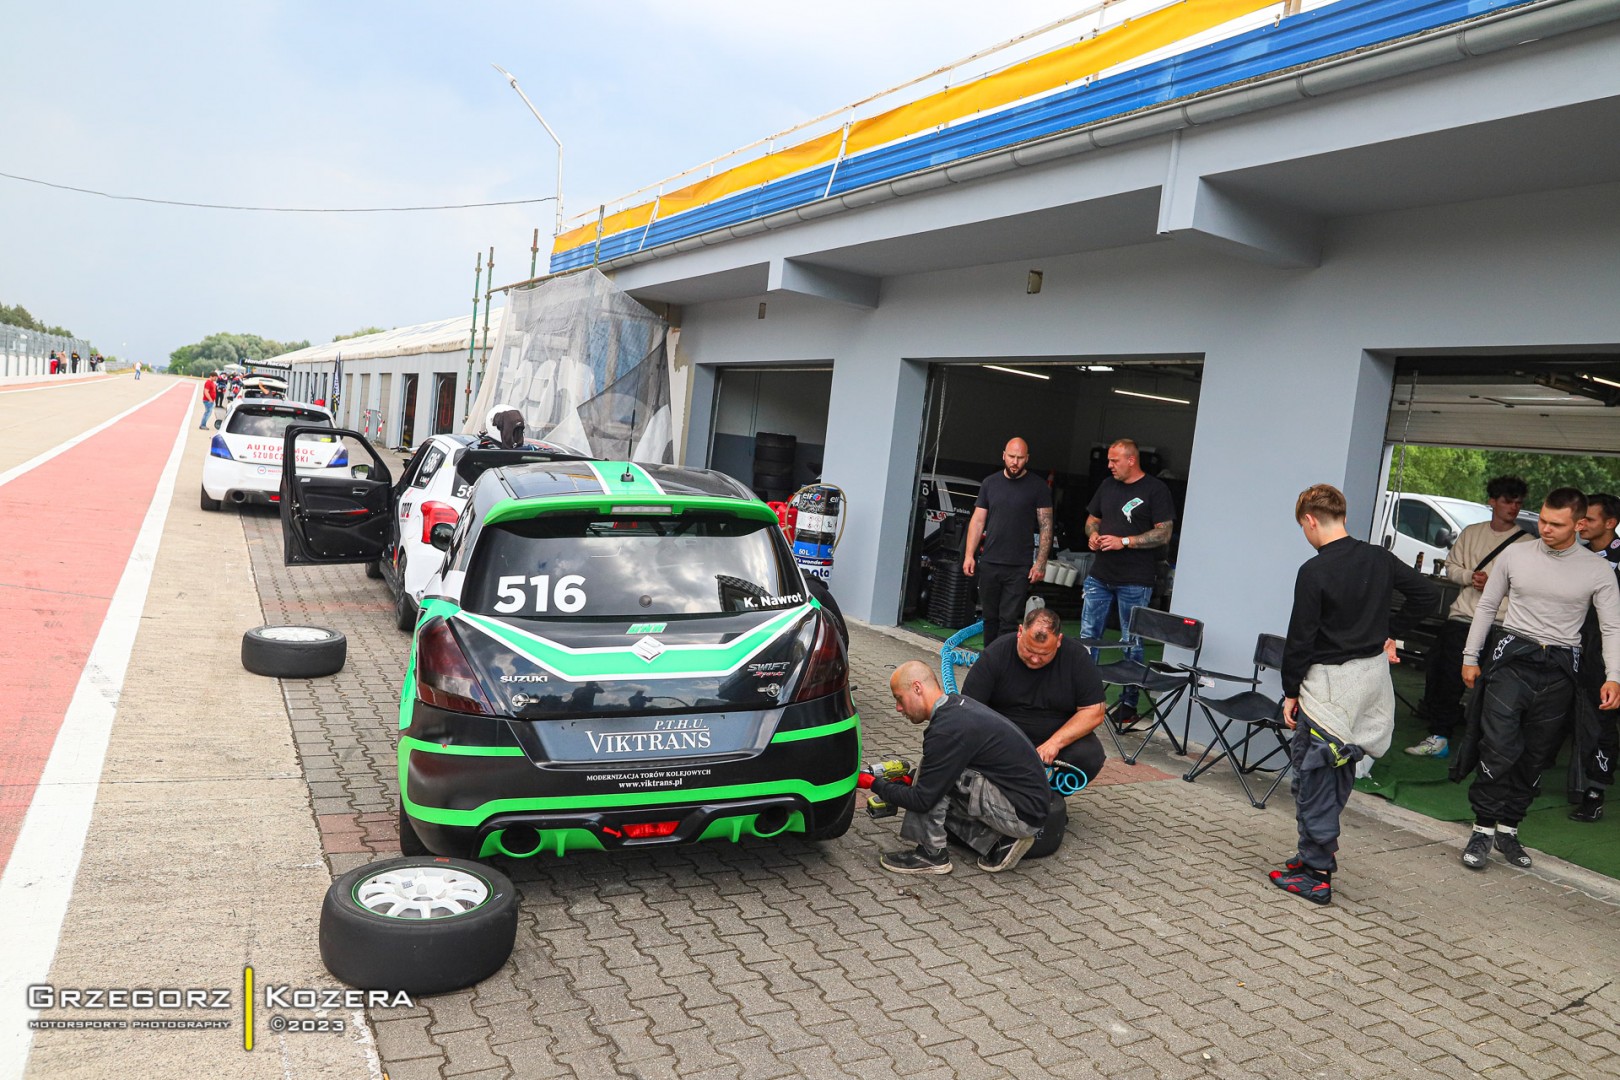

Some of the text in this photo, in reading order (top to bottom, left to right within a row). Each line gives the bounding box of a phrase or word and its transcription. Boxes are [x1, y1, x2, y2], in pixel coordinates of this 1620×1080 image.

[246, 443, 316, 456] AUTOPMOC
[802, 492, 813, 500] elf
[493, 574, 587, 613] 516
[743, 592, 803, 608] K. Nawrot
[747, 661, 791, 671] SWIFT
[499, 675, 548, 683] SUZUKI
[654, 719, 708, 730] P.T.H.U.
[586, 769, 711, 781] MODERNIZACJA TORÓW KOLEJOWYCH
[618, 778, 682, 788] www.viktrans.pl
